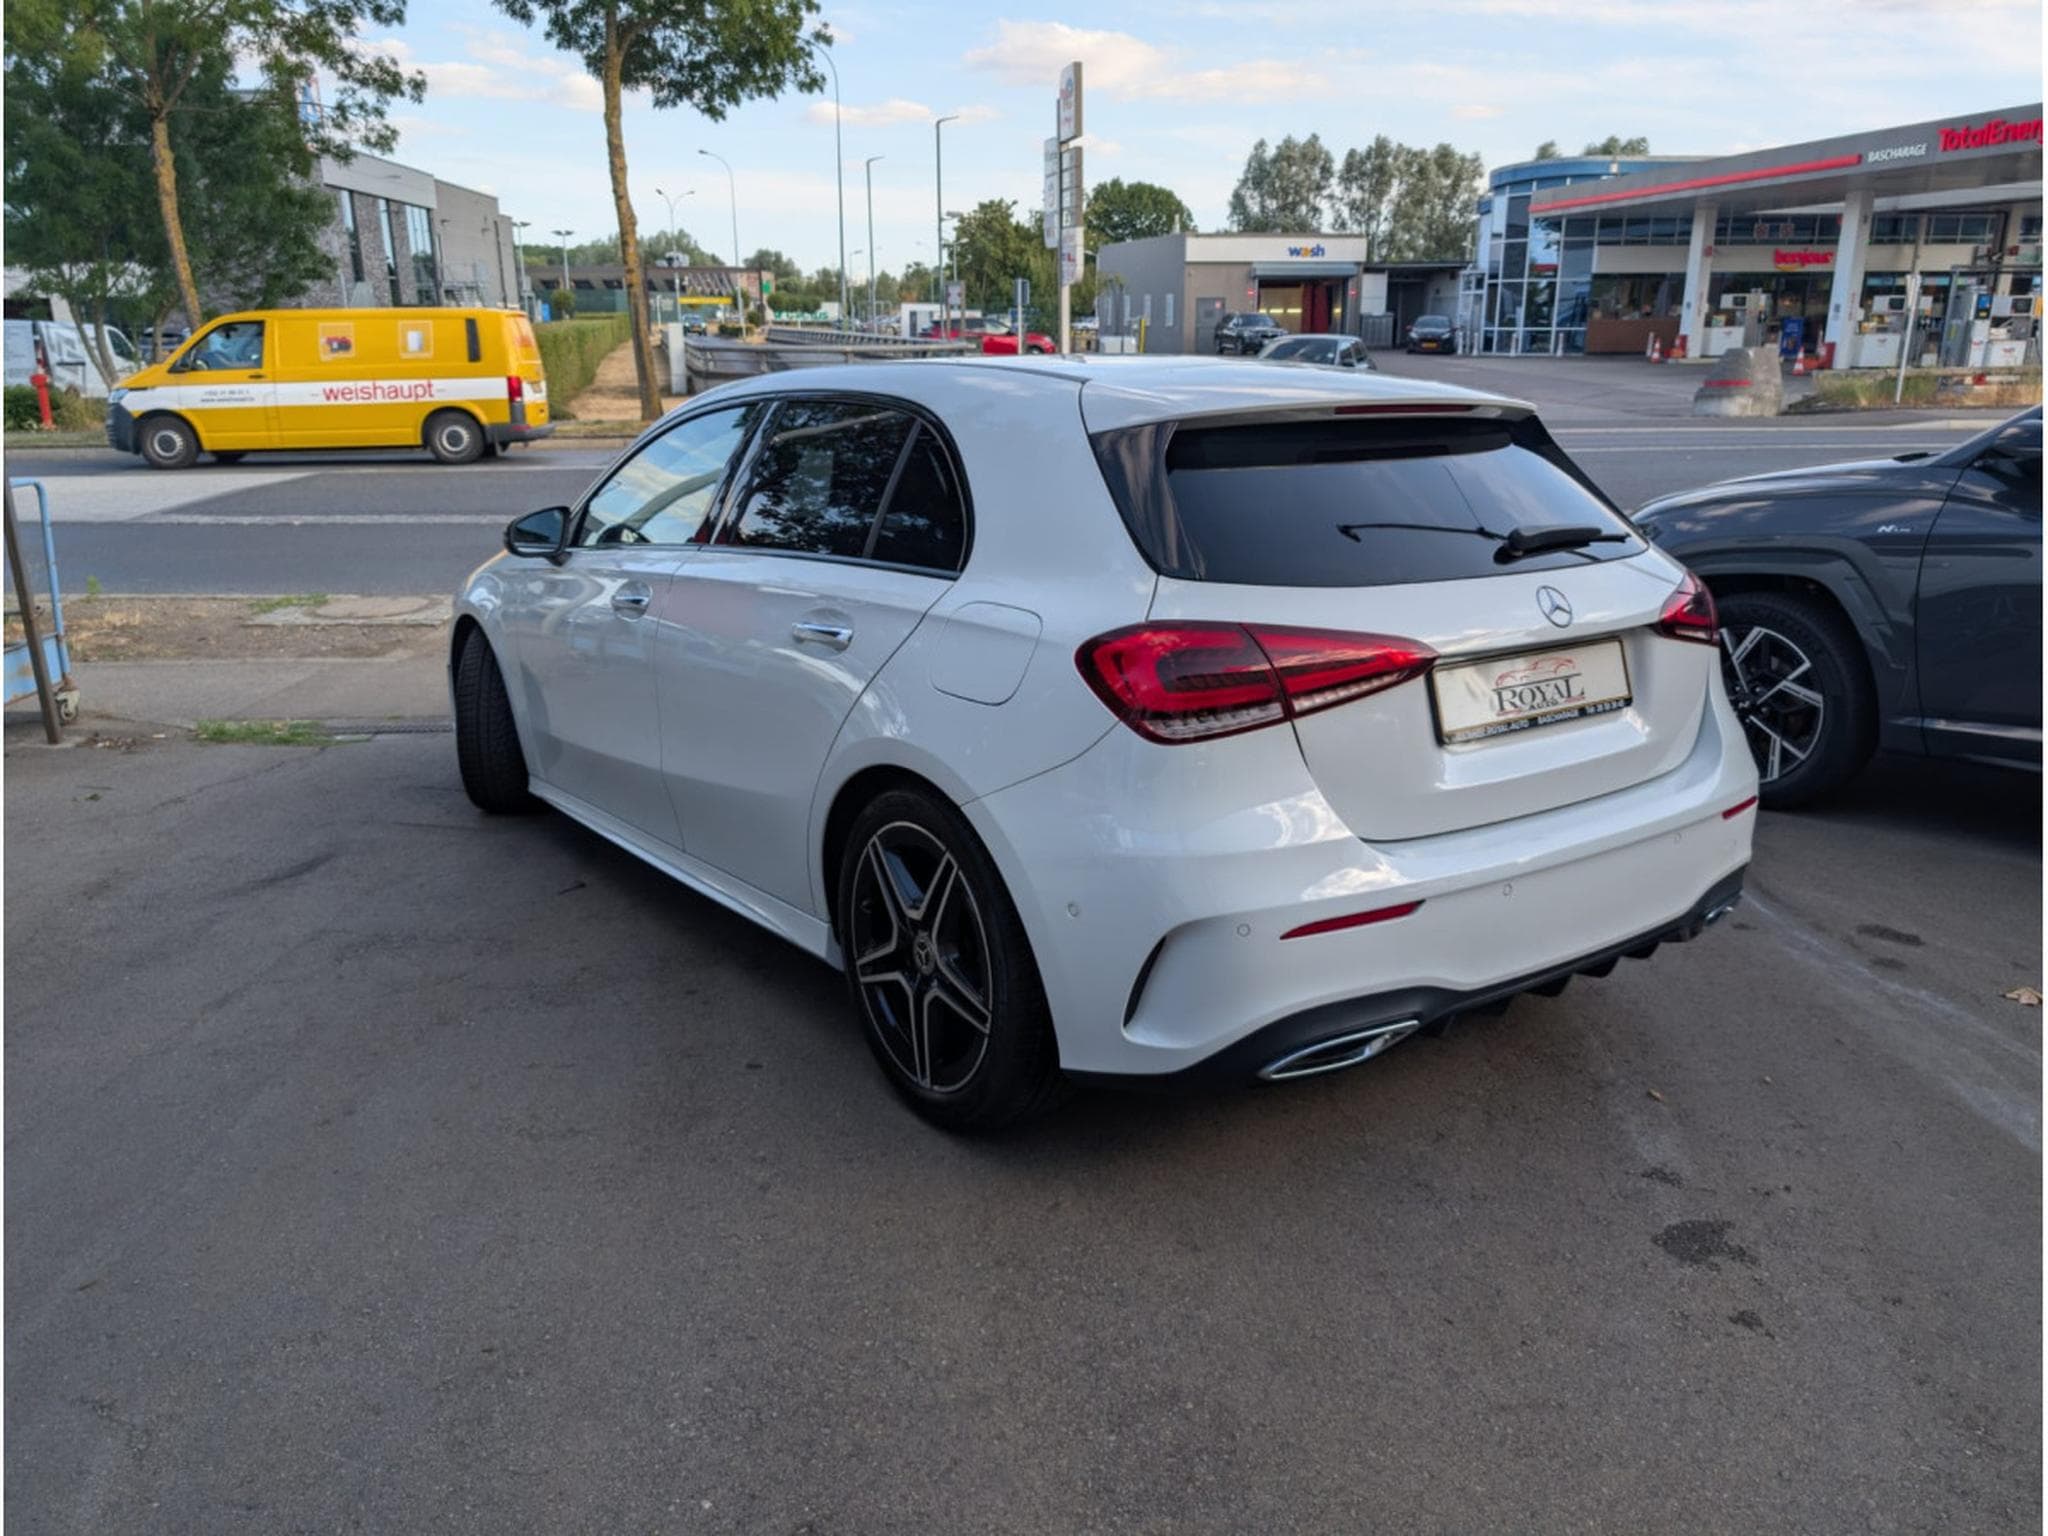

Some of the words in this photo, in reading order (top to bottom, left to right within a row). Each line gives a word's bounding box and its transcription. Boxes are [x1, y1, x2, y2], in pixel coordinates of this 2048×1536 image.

[1938, 119, 2043, 152] TotalEner
[1868, 143, 1928, 163] BASCHARAGE
[1288, 243, 1326, 257] wash
[322, 380, 434, 402] weishaupt
[1495, 678, 1585, 712] ROYAL
[1529, 698, 1559, 711] AUTO
